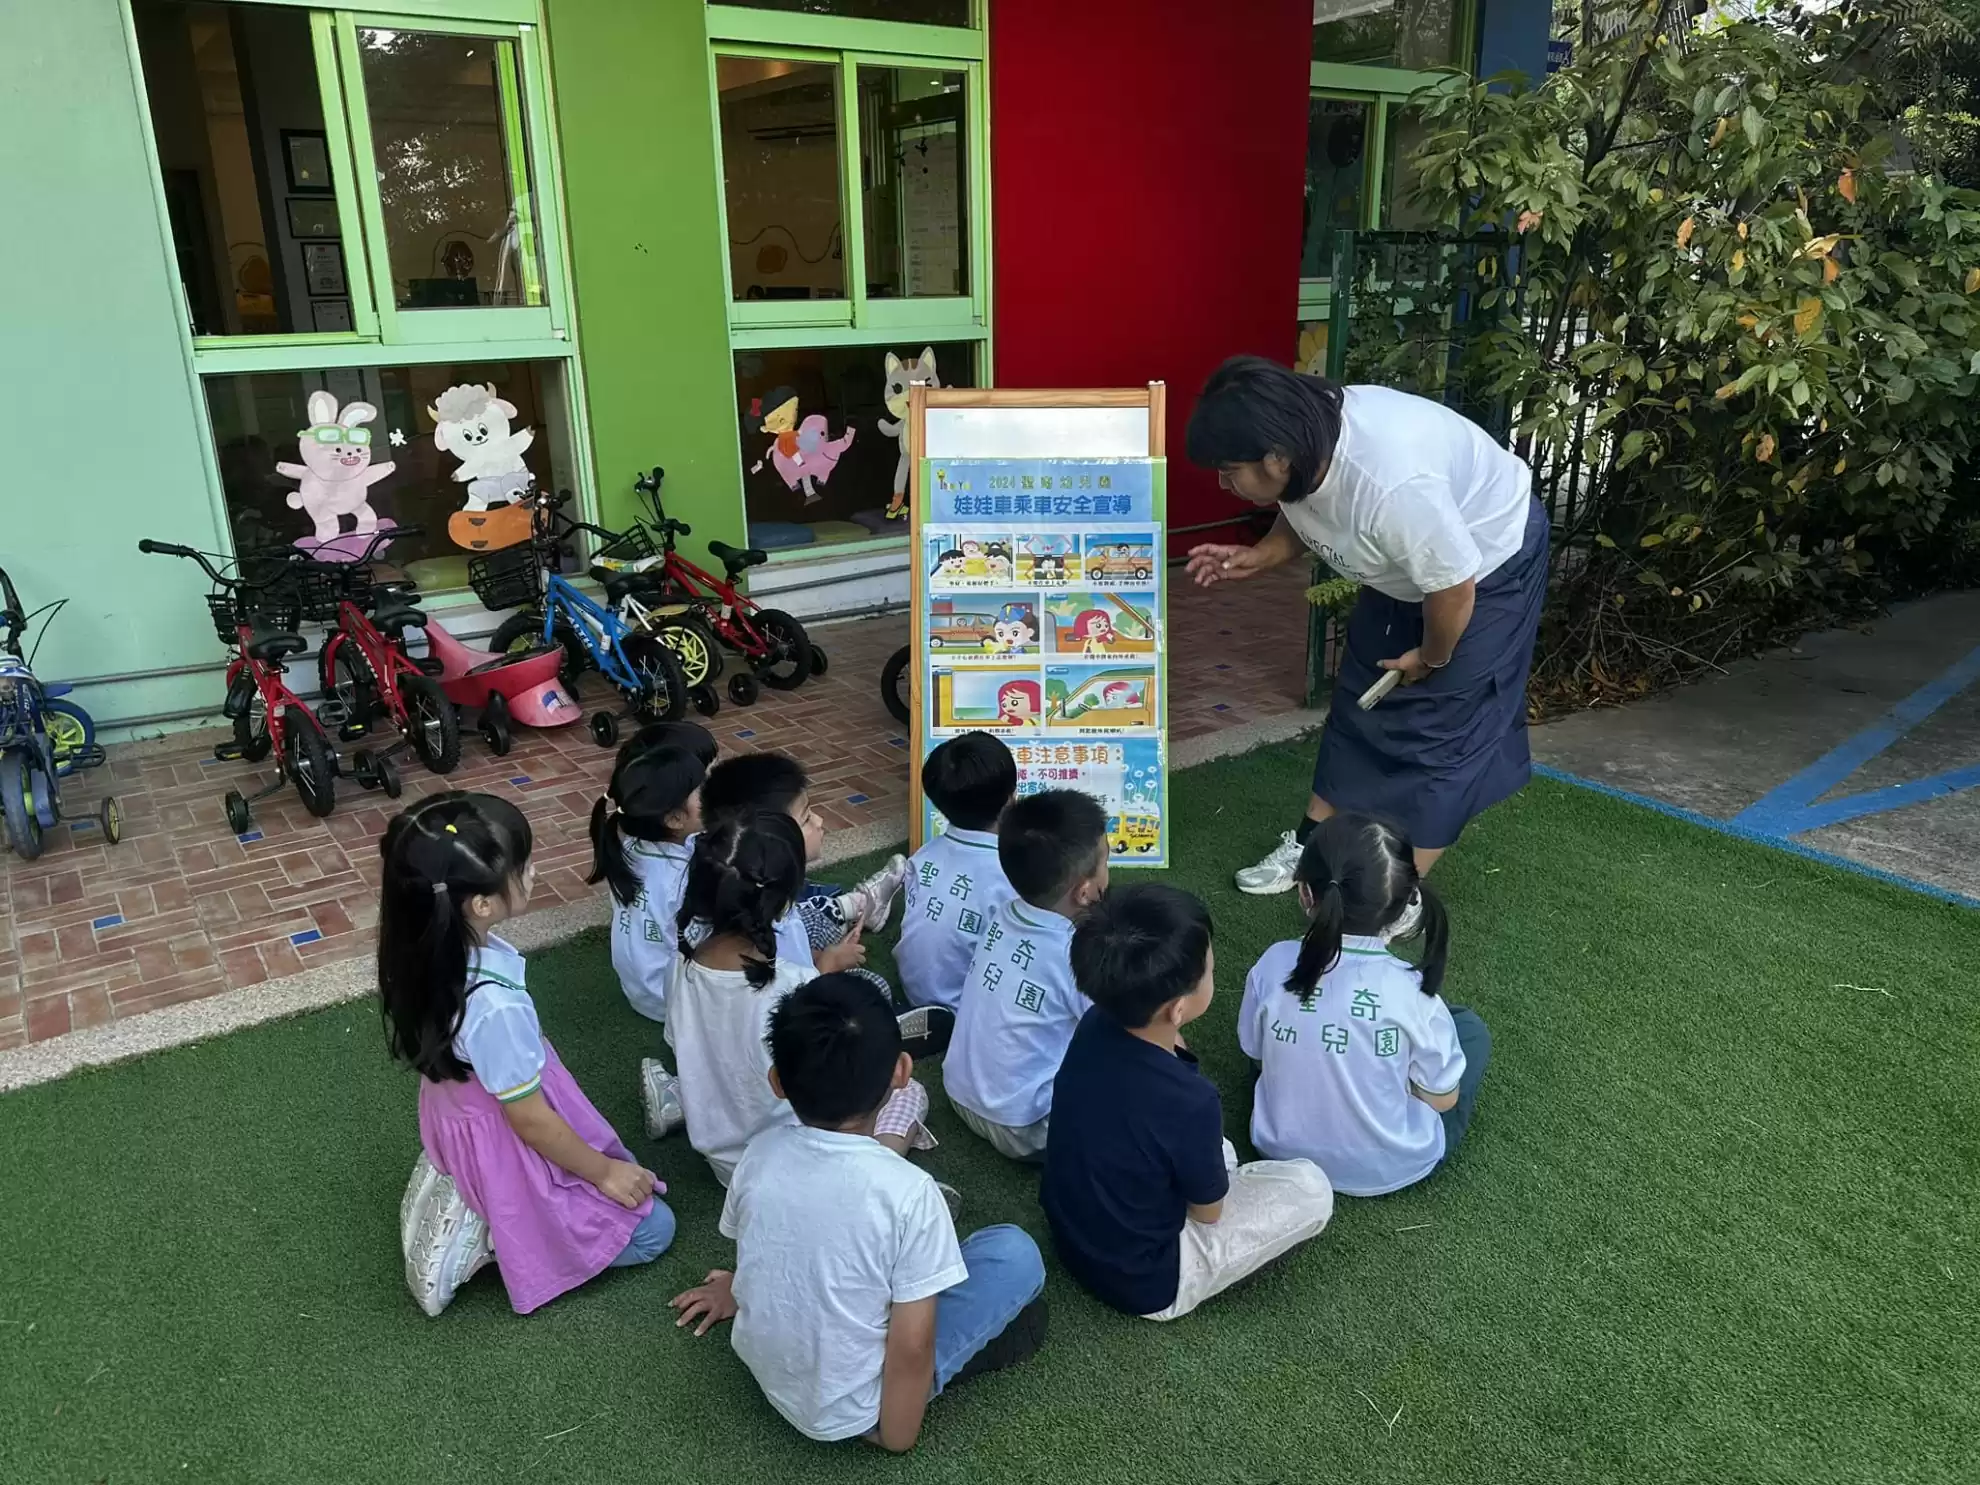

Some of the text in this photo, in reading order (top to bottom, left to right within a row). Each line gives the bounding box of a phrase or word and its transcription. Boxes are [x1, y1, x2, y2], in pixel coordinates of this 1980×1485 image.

[954, 495, 1132, 516] 娃娃車乘車安全宣導
[1011, 745, 1121, 765] 車注意事項：
[920, 861, 973, 901] 聖奇
[984, 921, 1036, 971] 聖奇
[1271, 1020, 1399, 1058] 幼兒園
